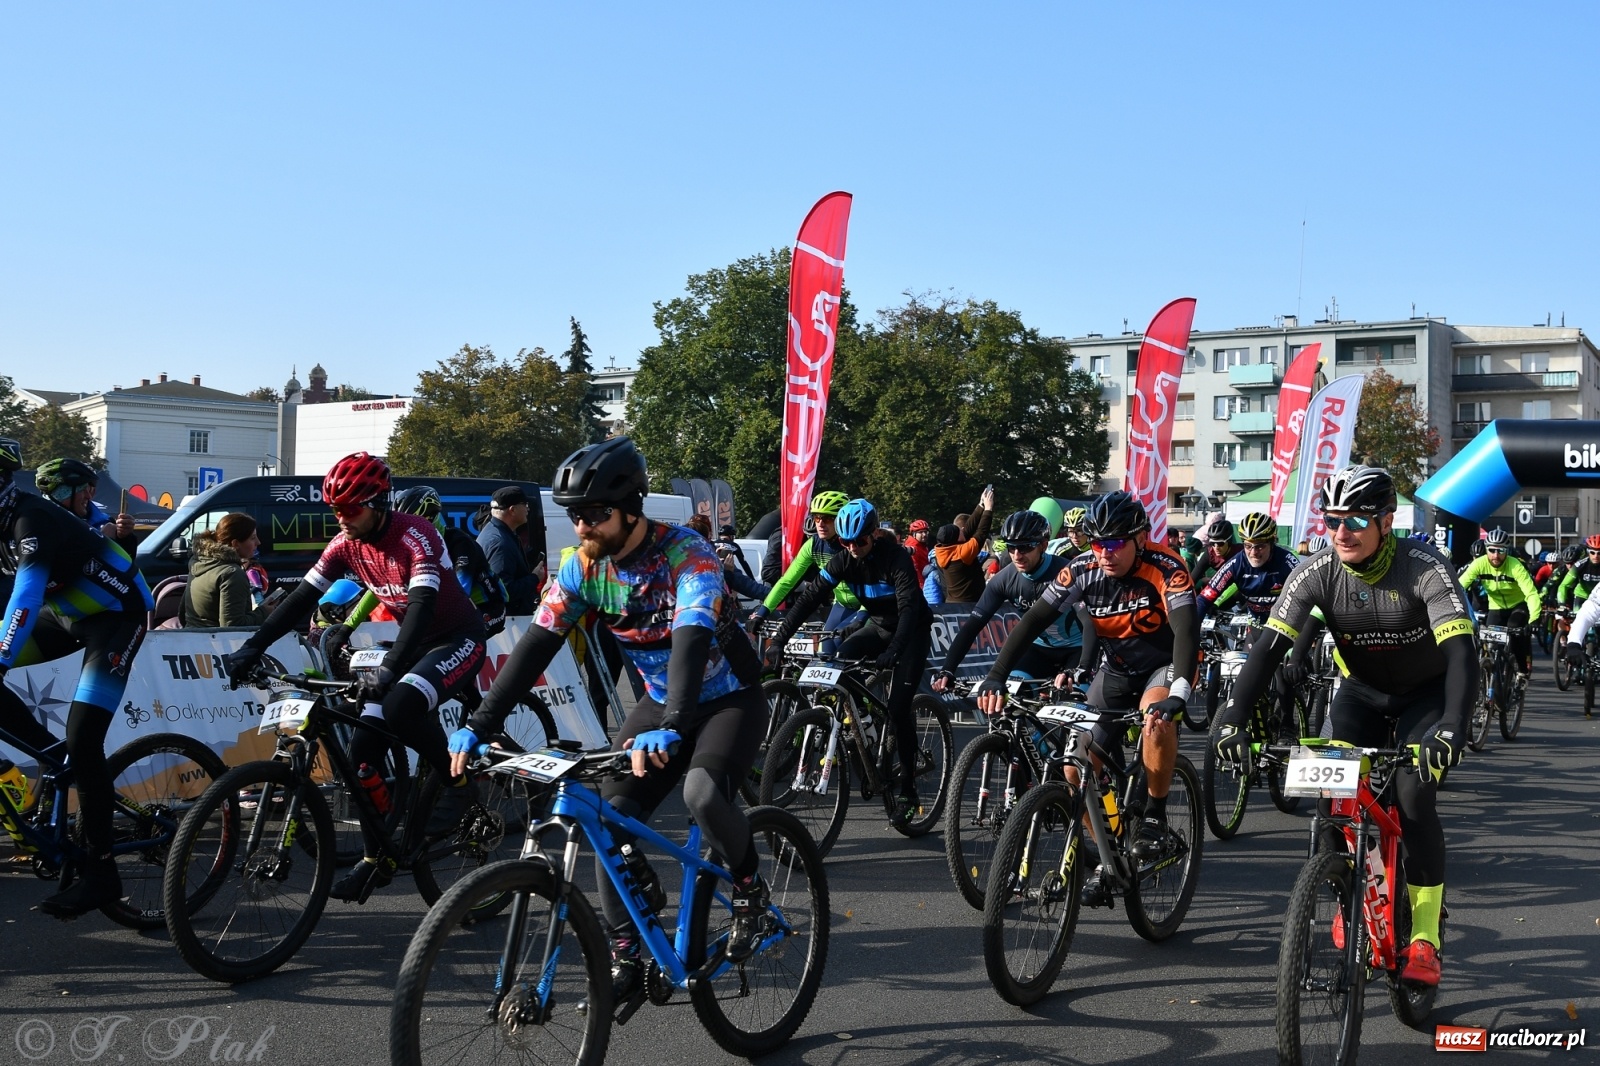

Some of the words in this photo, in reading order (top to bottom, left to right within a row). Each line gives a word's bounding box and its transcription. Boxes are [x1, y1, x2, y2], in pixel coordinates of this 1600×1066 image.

[1518, 509, 1531, 525] 0
[1278, 553, 1334, 619] garbaruk
[1407, 548, 1465, 613] garbaruk
[1, 608, 24, 652] Viktoria
[1402, 630, 1428, 645] HOME
[356, 653, 380, 662] 3294
[435, 653, 459, 676] Mad
[458, 638, 477, 661] Mobil
[441, 642, 485, 689] NISSAN
[807, 669, 834, 681] 3041
[269, 703, 301, 721] 1196
[1047, 708, 1087, 721] 1448
[1298, 766, 1346, 783] 1395
[1153, 856, 1178, 872] SCOTT
[606, 845, 662, 933] TREK
[733, 899, 749, 907] SIDI
